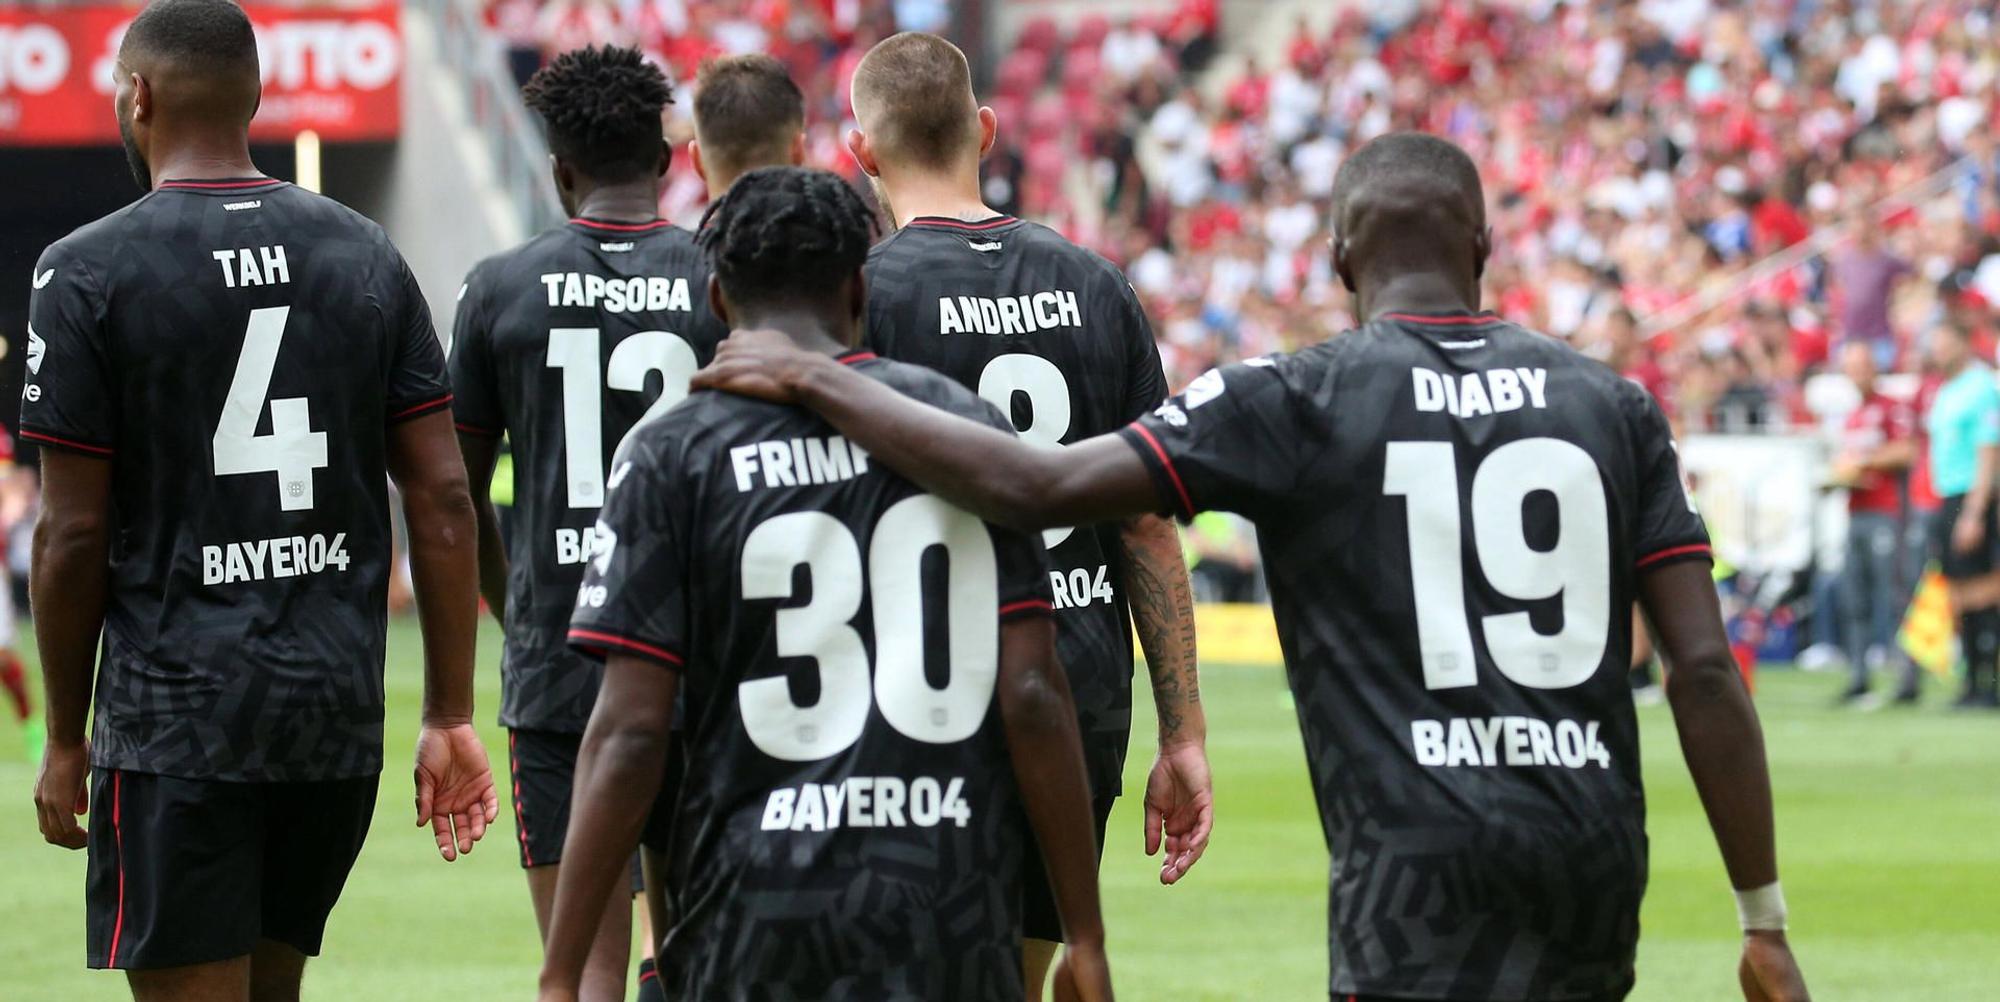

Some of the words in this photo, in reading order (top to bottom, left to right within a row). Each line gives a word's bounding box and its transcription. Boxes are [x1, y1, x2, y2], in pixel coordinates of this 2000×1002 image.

[213, 246, 290, 287] TAH
[541, 272, 692, 313] TAPSOBA
[940, 290, 1082, 335] ANDRICH
[213, 306, 328, 512] 4
[1412, 367, 1547, 419] DIABY
[203, 533, 350, 586] BAYER04
[1383, 437, 1610, 690] 19
[738, 494, 998, 761] 30
[1411, 716, 1611, 769] BAYER04
